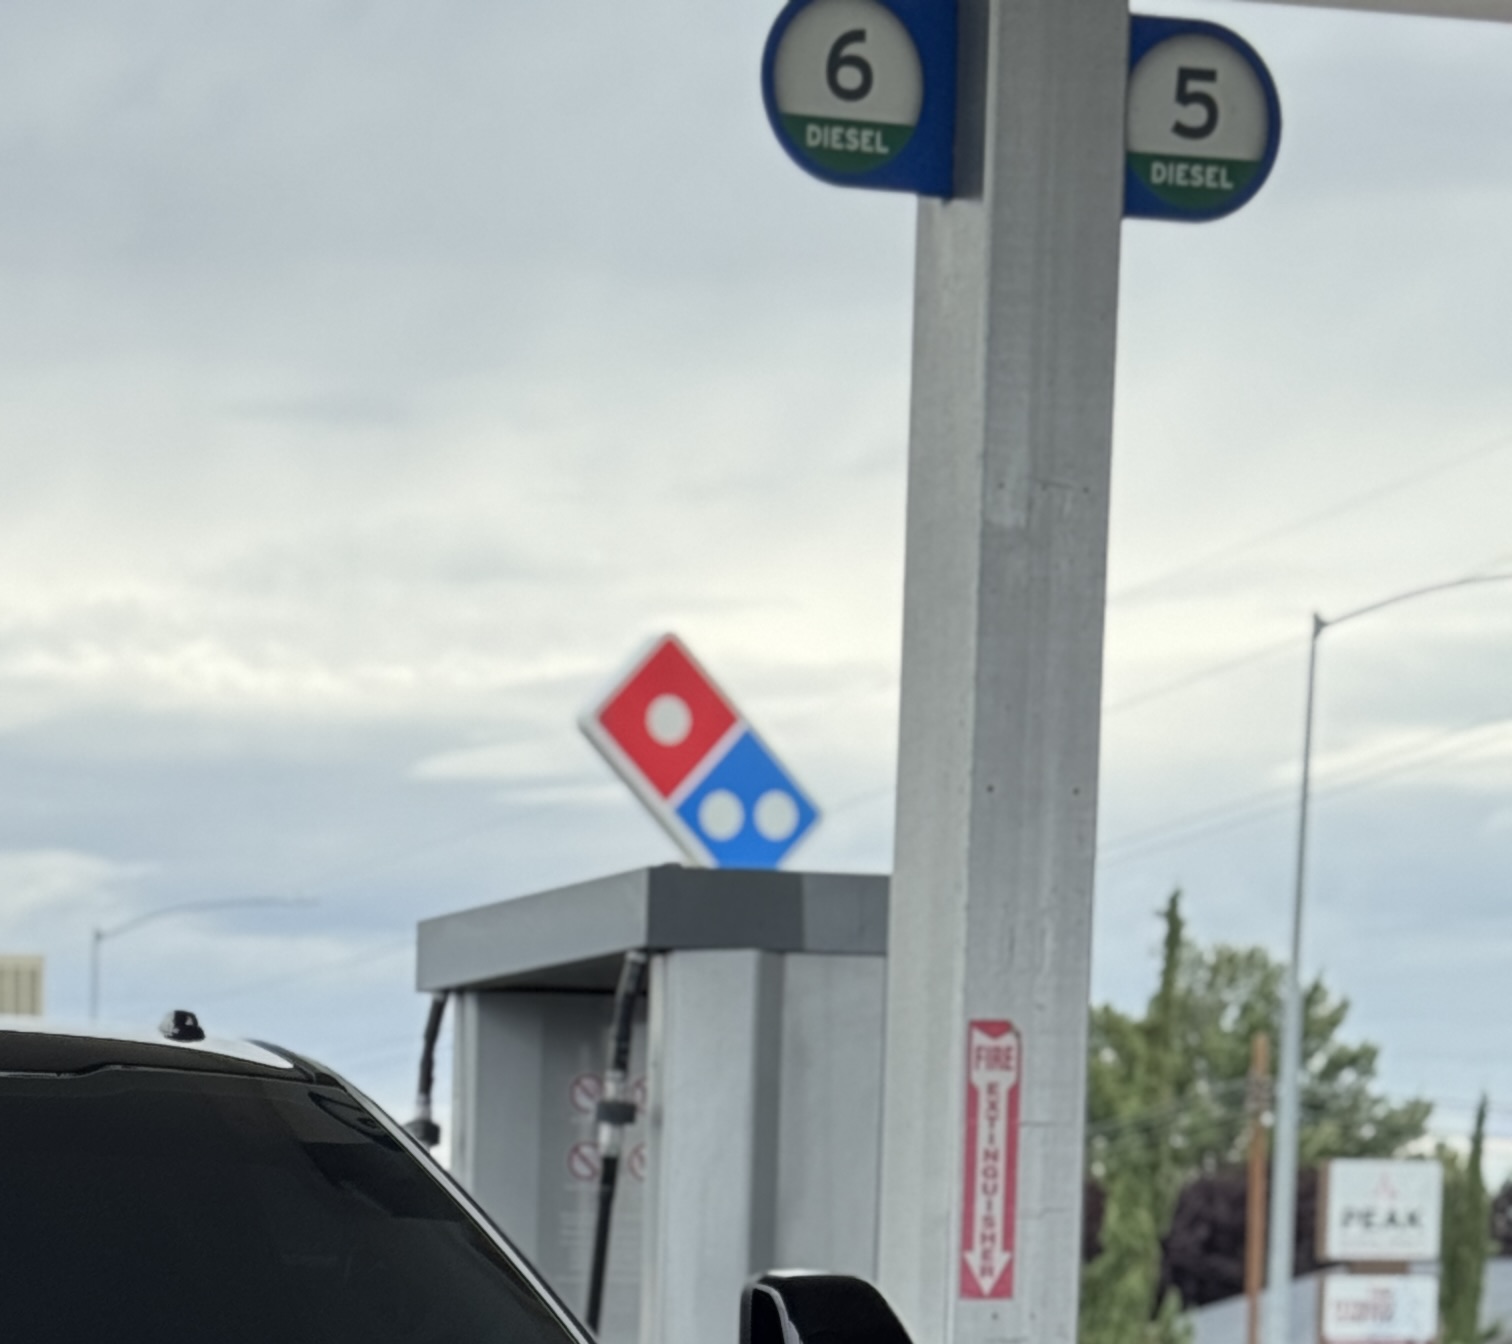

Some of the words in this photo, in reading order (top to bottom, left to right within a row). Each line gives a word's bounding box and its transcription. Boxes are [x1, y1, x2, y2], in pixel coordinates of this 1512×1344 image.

[825, 28, 874, 102] 6
[1170, 66, 1219, 140] 5
[805, 123, 889, 154] DIESEL
[1150, 160, 1234, 190] DIESEL
[974, 1044, 1015, 1072] FIRE
[979, 1081, 1000, 1278] EXTINGUISHER
[1340, 1207, 1424, 1230] PEAK
